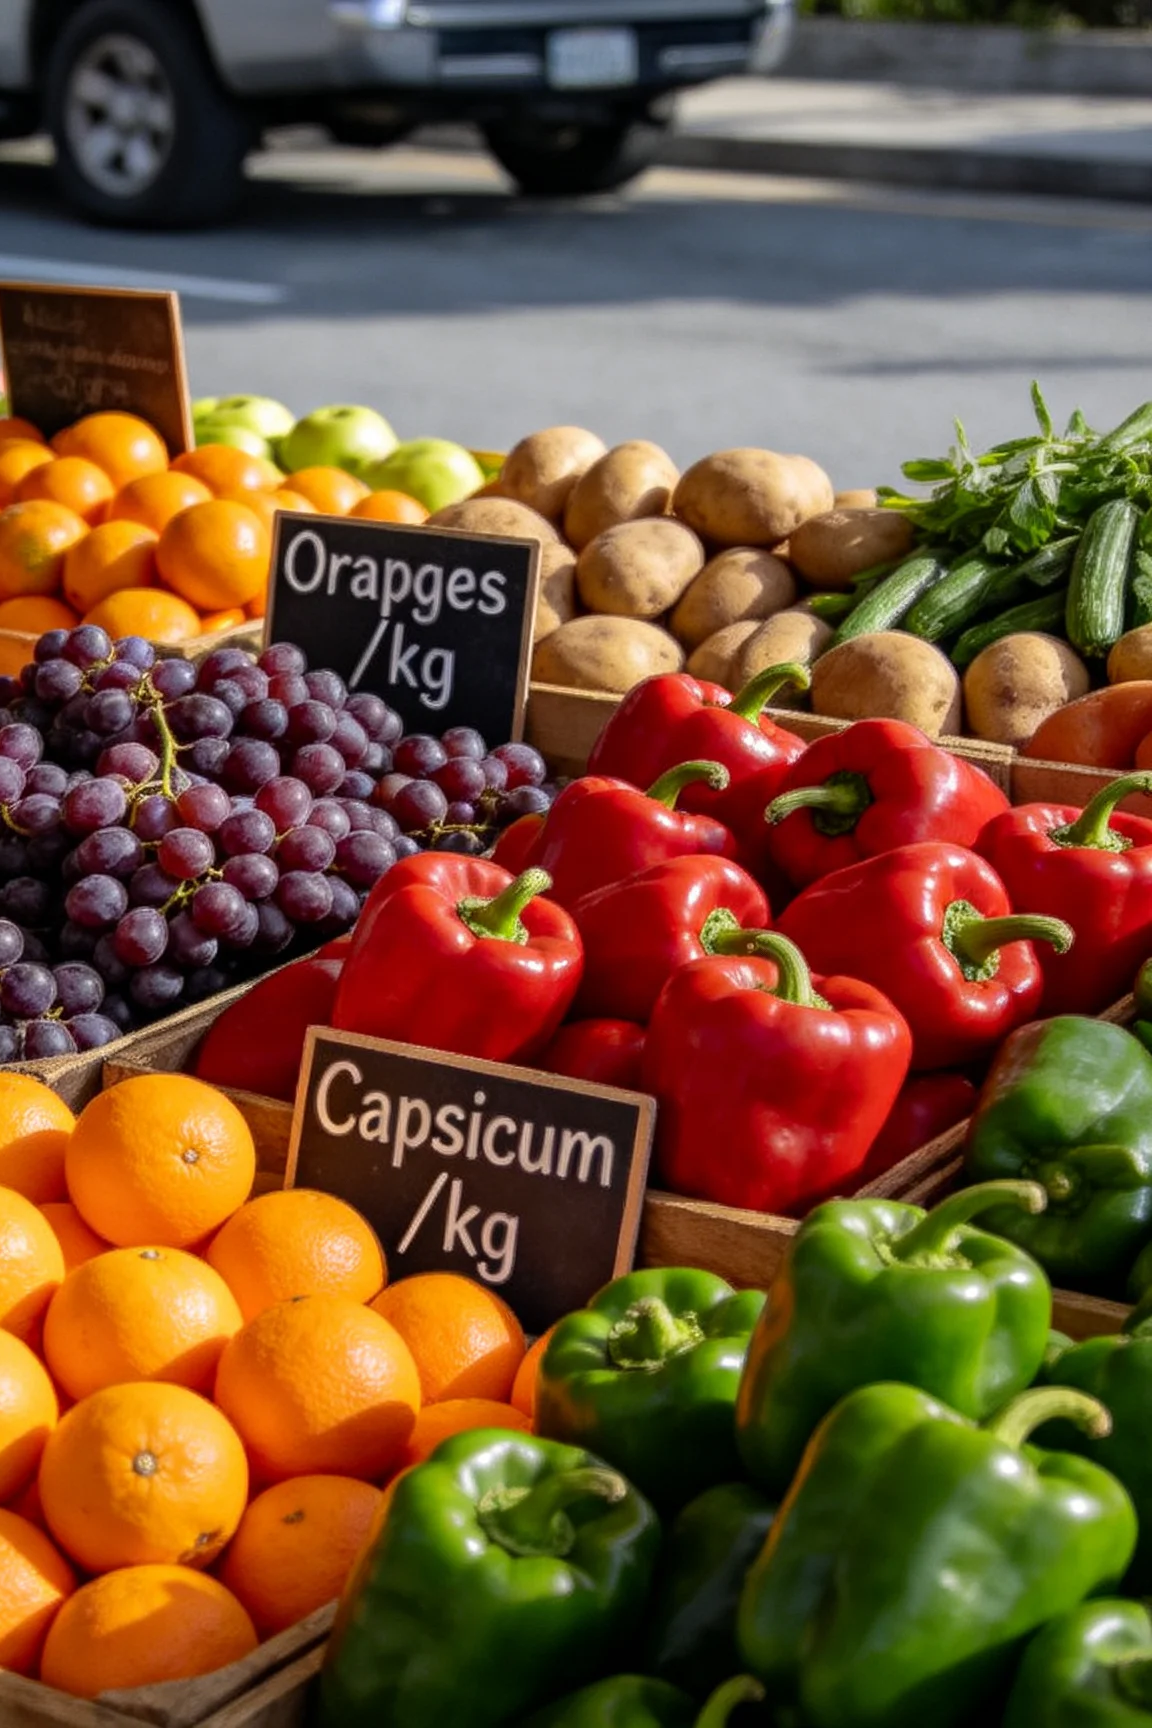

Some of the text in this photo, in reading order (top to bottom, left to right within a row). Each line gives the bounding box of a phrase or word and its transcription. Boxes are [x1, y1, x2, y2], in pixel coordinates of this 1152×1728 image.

[349, 618, 455, 710] /kg
[315, 1060, 615, 1188] Capsicum
[397, 1171, 520, 1285] /kg
